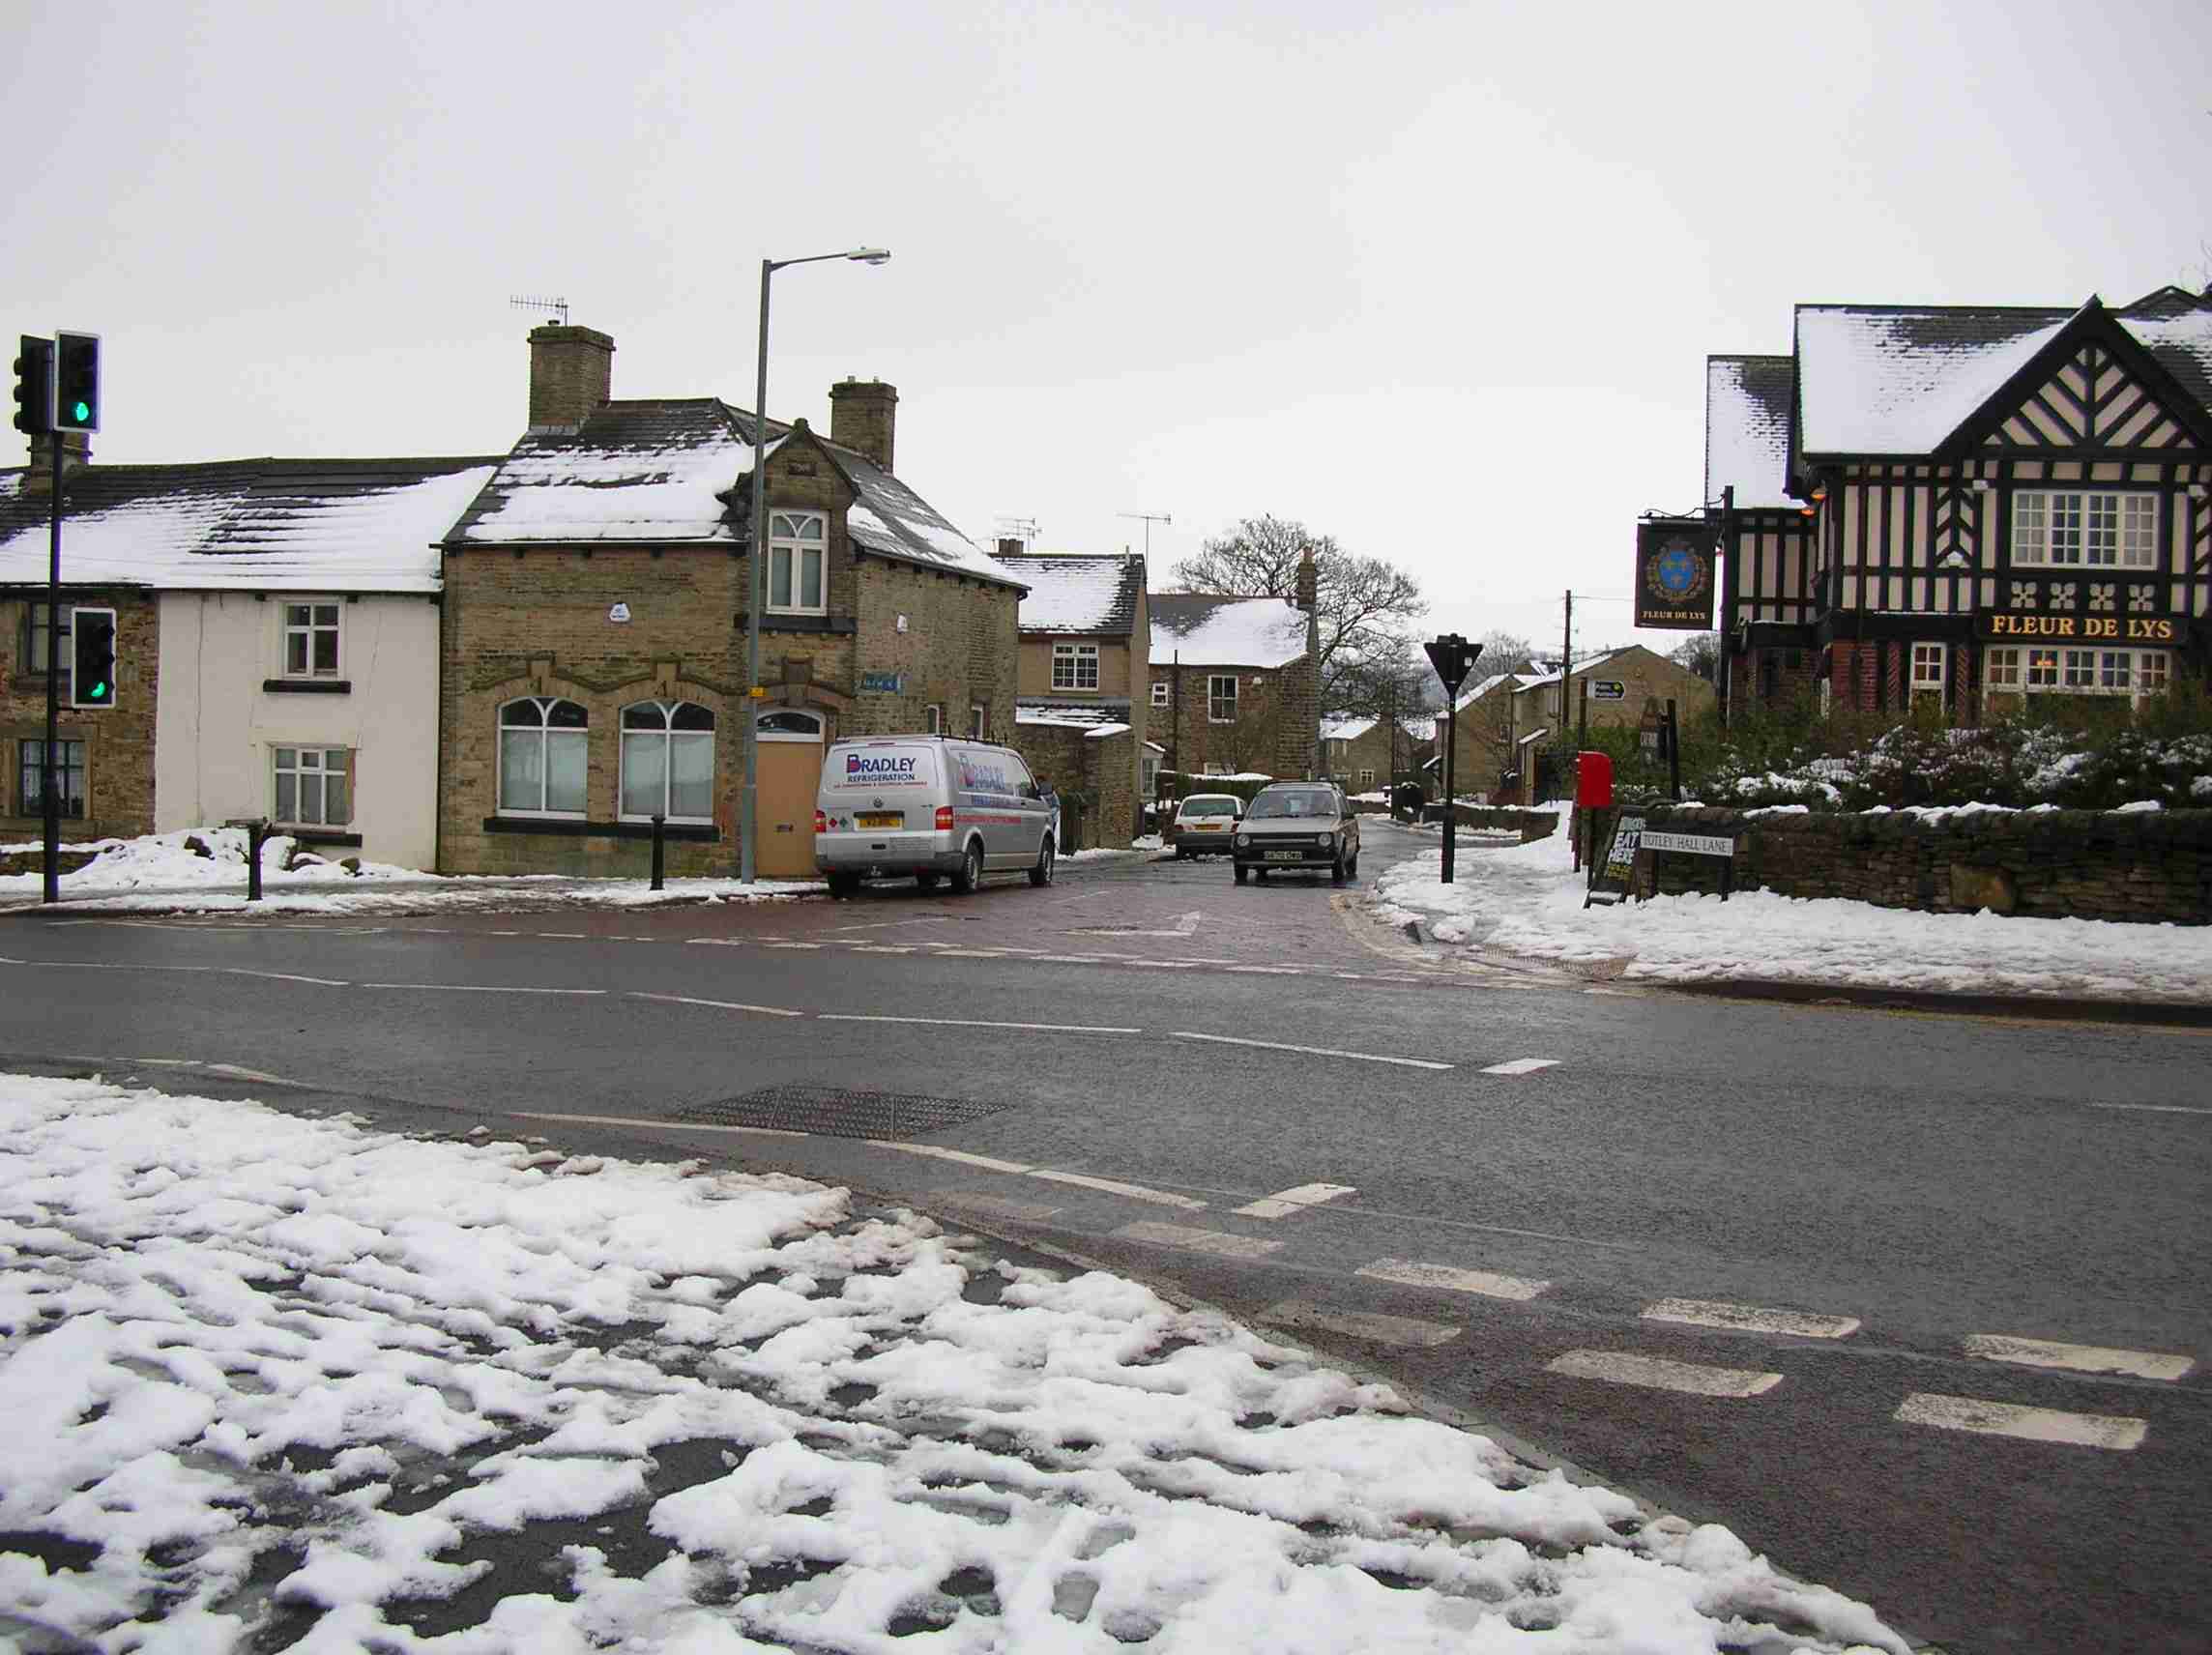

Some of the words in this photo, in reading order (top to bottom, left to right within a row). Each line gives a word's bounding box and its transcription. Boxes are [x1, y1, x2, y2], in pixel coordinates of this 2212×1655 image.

[1992, 615, 2075, 635] FLEUR
[2084, 618, 2118, 636] DE
[2127, 619, 2173, 639] LYS
[846, 754, 917, 773] BRADLEY
[847, 772, 916, 782] REFRIGERATION
[1614, 832, 1638, 849] EAT
[1644, 834, 1673, 848] TOTLEY
[1677, 838, 1702, 851] HALL
[1703, 841, 1727, 853] LANE
[1609, 850, 1634, 864] HERE
